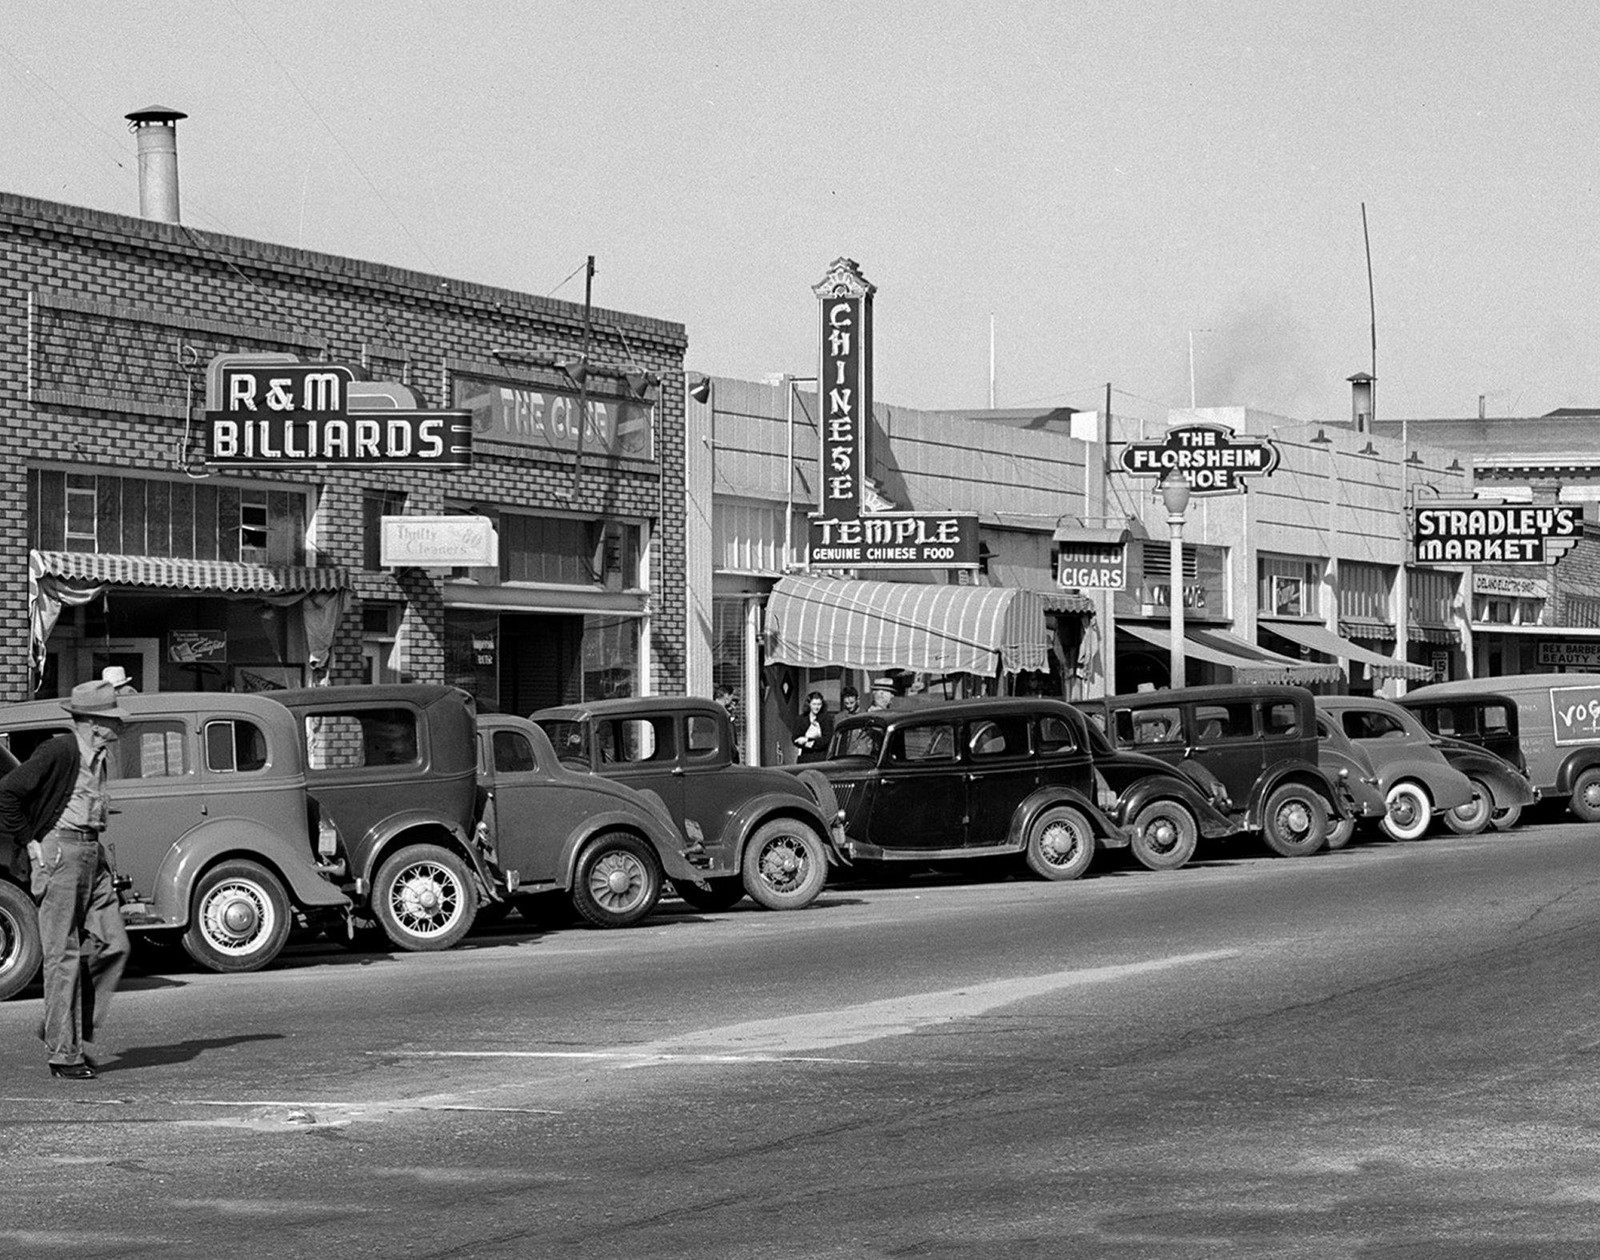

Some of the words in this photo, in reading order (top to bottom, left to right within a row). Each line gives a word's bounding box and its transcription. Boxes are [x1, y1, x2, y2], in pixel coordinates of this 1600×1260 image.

[828, 302, 853, 500] CHINESE
[500, 386, 546, 438] THE
[213, 419, 444, 458] BILLIARDS
[1178, 431, 1216, 447] THE
[1133, 449, 1262, 468] FLORSHEIM
[1186, 469, 1228, 488] HOE
[813, 517, 961, 545] TEMPLE
[1418, 507, 1574, 536] STRADLEY'S
[812, 548, 861, 560] GENUINE
[866, 548, 917, 560] CHINESE
[923, 548, 955, 560] FOOD
[1062, 546, 1122, 564] UNITED
[1418, 539, 1540, 560] MARKET
[1062, 567, 1122, 588] CIGARS
[1543, 644, 1561, 653] REX
[1543, 653, 1589, 663] BEAUTY
